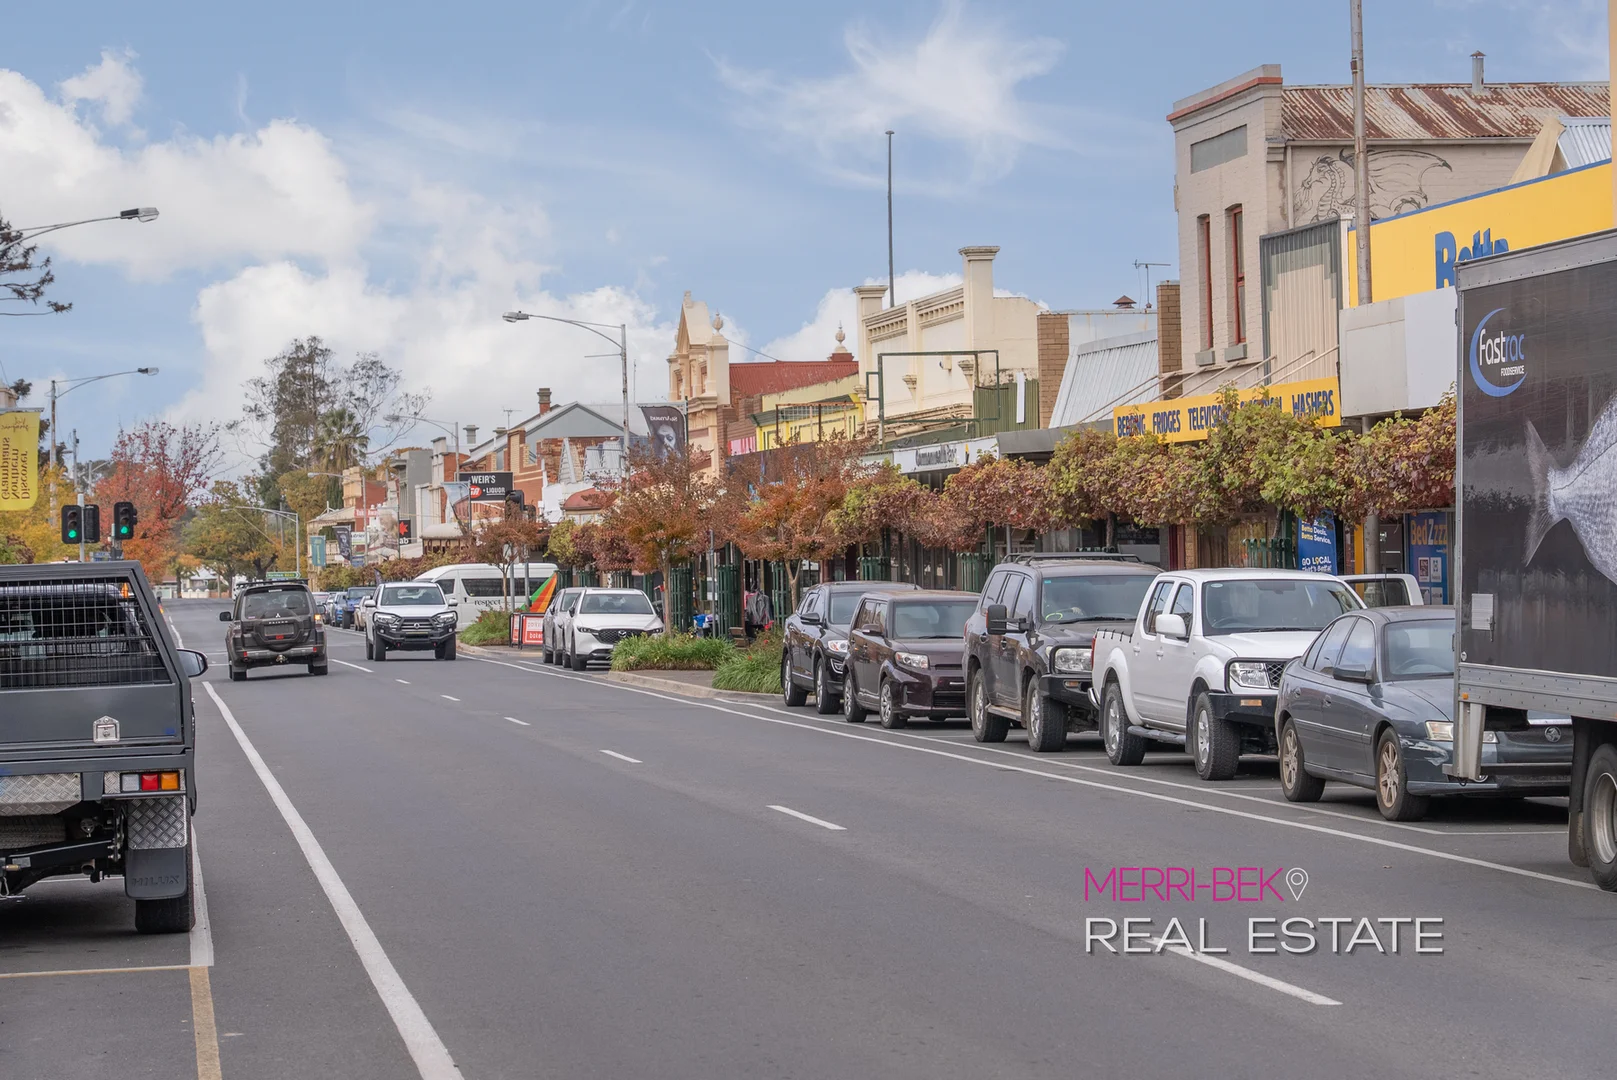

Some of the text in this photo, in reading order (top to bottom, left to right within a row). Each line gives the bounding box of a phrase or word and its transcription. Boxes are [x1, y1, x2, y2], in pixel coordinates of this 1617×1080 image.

[1478, 329, 1525, 366] fastrac
[1500, 364, 1525, 377] FOODSERVICE
[1117, 413, 1146, 437] BEDDING
[1152, 410, 1181, 434] FRIDGES
[1292, 389, 1335, 417] WASHERS
[471, 475, 496, 484] WEIR'S
[1301, 556, 1332, 566] GO LOCAL
[474, 599, 502, 607] respect
[131, 875, 180, 887] HILUX
